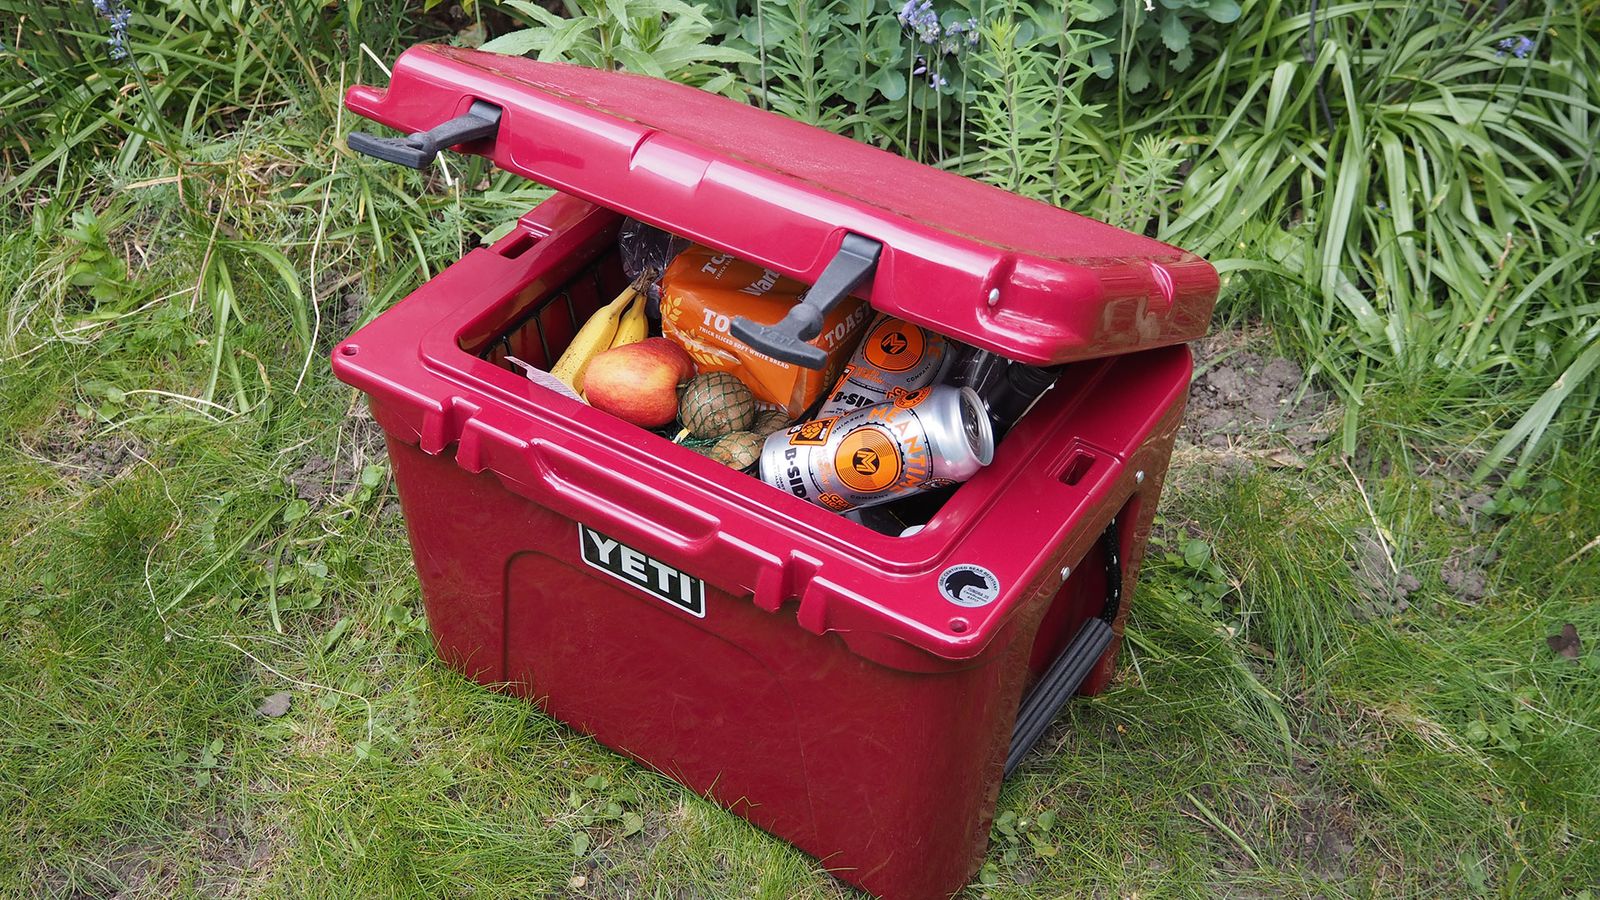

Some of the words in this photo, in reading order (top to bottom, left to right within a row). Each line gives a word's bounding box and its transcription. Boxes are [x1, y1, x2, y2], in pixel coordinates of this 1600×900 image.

[701, 253, 734, 275] TO
[703, 308, 732, 336] TO
[699, 326, 714, 337] THICK
[715, 333, 733, 346] SLICED
[734, 342, 748, 353] SOFT
[749, 348, 768, 361] WHITE
[769, 357, 790, 369] BREAD
[906, 363, 932, 383] COMPANY
[785, 447, 812, 502] B-SID
[587, 528, 692, 604] YETI
